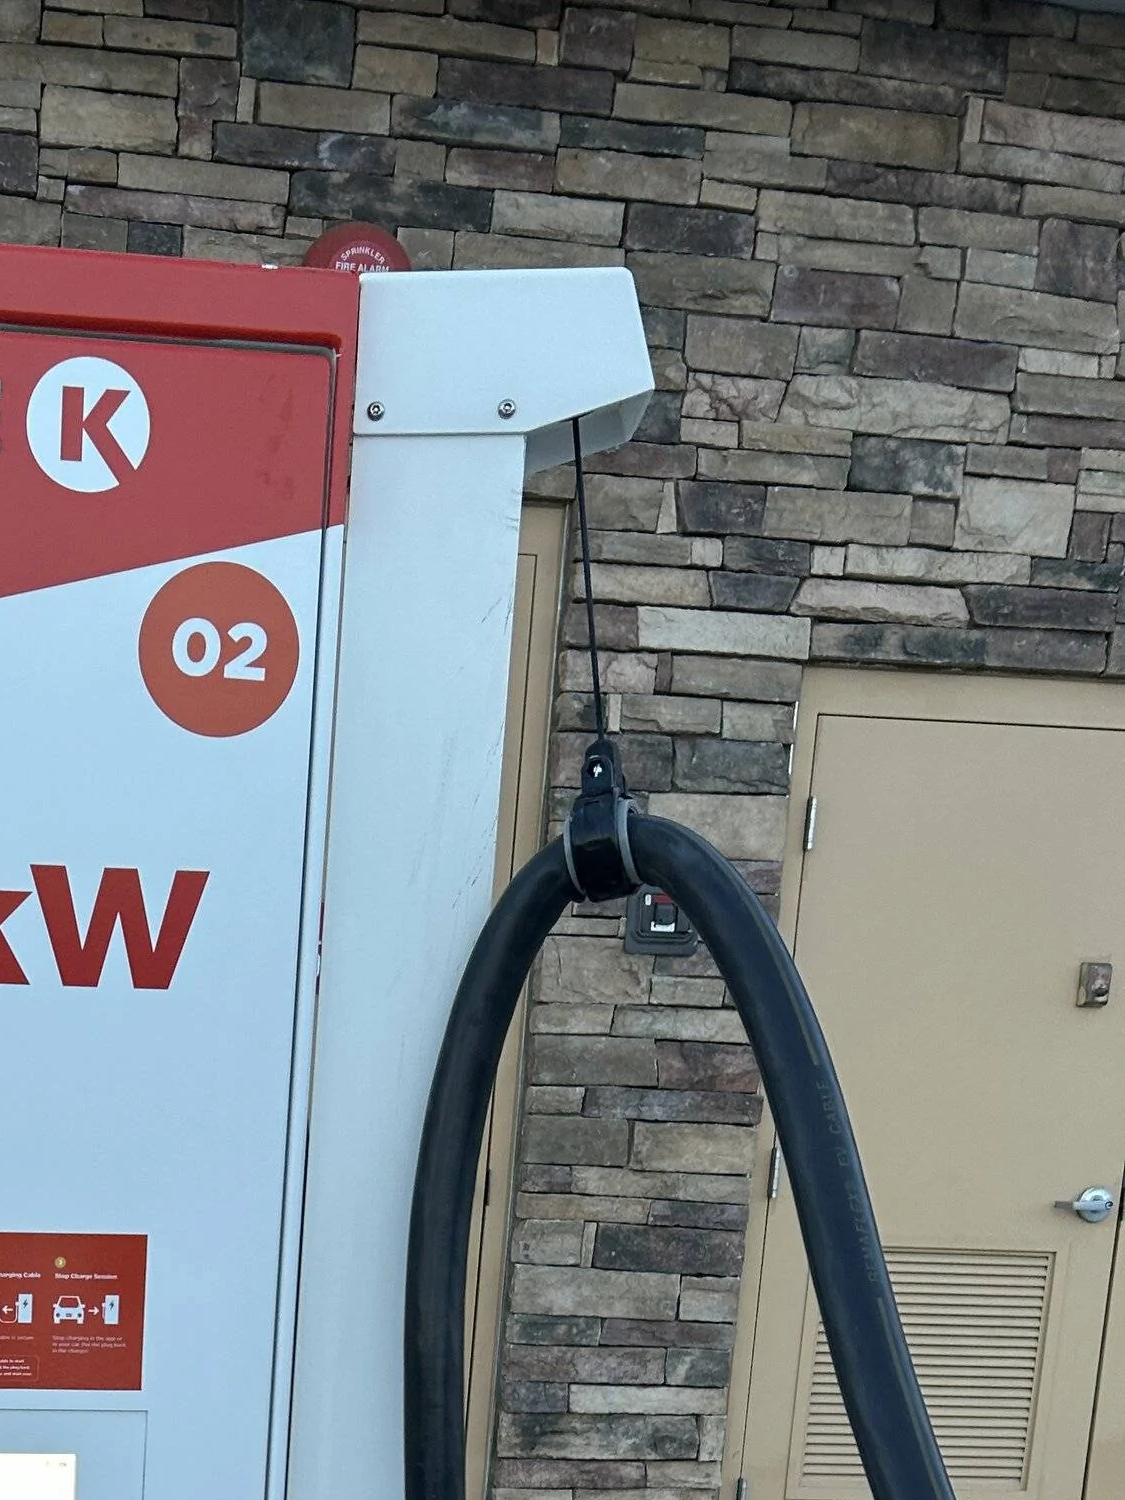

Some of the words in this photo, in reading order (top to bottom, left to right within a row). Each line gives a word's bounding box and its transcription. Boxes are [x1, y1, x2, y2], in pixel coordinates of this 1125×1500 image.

[341, 246, 386, 264] SPRINKLER
[335, 261, 356, 271] FIRE
[357, 263, 389, 272] ALARM
[172, 617, 269, 682] 02
